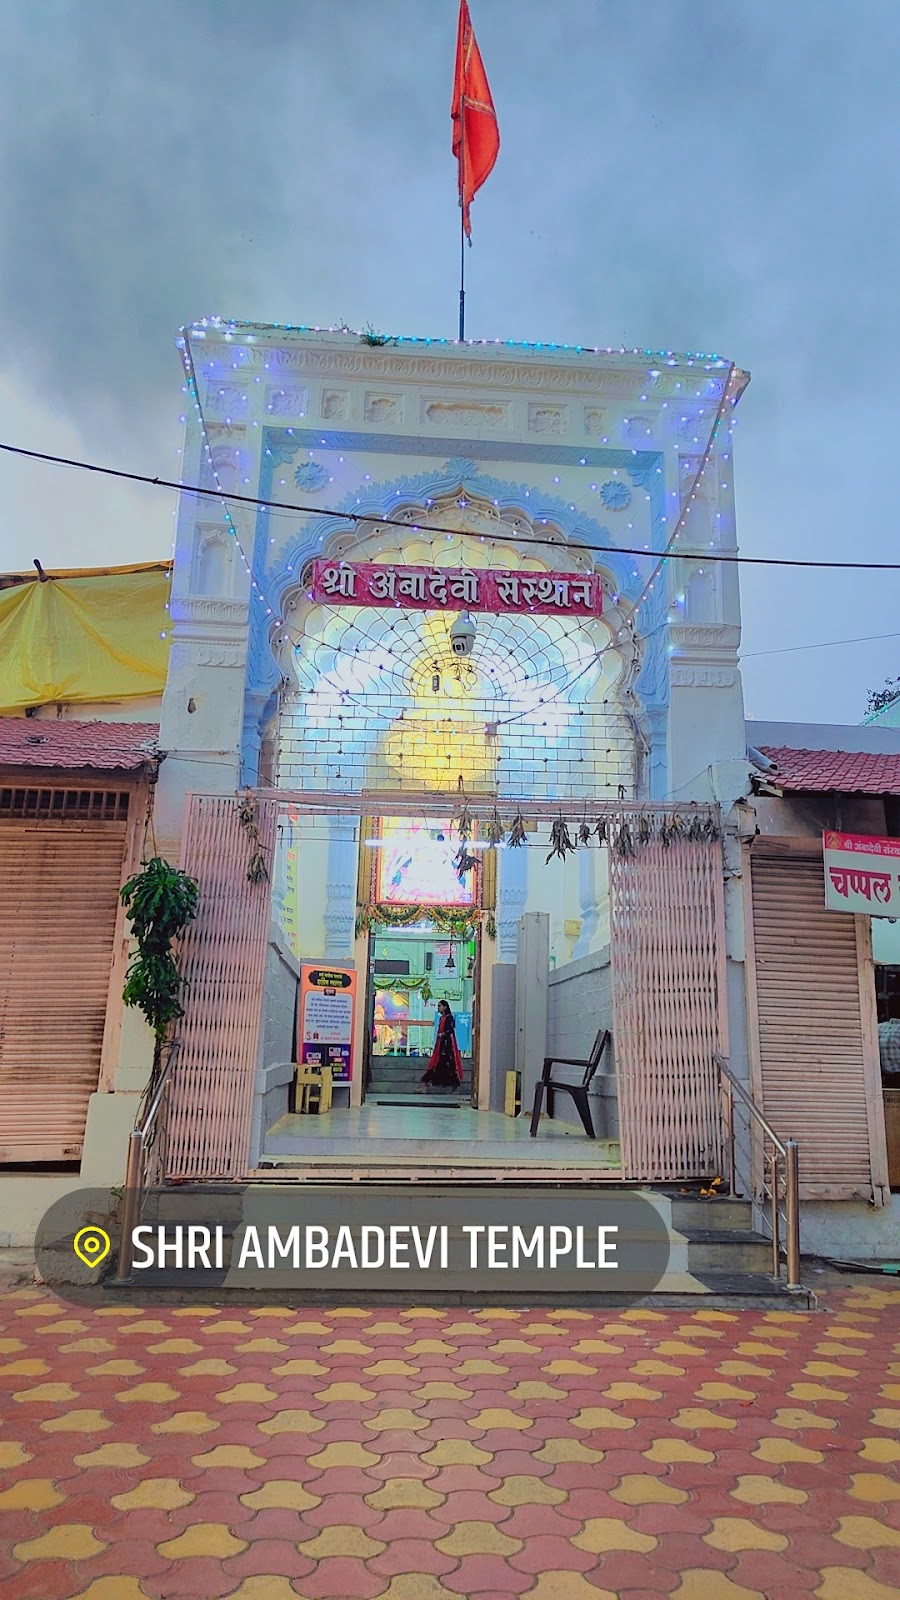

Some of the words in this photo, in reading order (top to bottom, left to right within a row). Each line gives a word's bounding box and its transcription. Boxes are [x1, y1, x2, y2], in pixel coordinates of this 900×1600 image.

[322, 561, 357, 598] श्री
[371, 566, 481, 604] अंबादेवी
[496, 572, 593, 608] संस्थान
[844, 839, 853, 850] श्री
[854, 841, 881, 853] अंबादेवी
[829, 866, 892, 904] चप्पल
